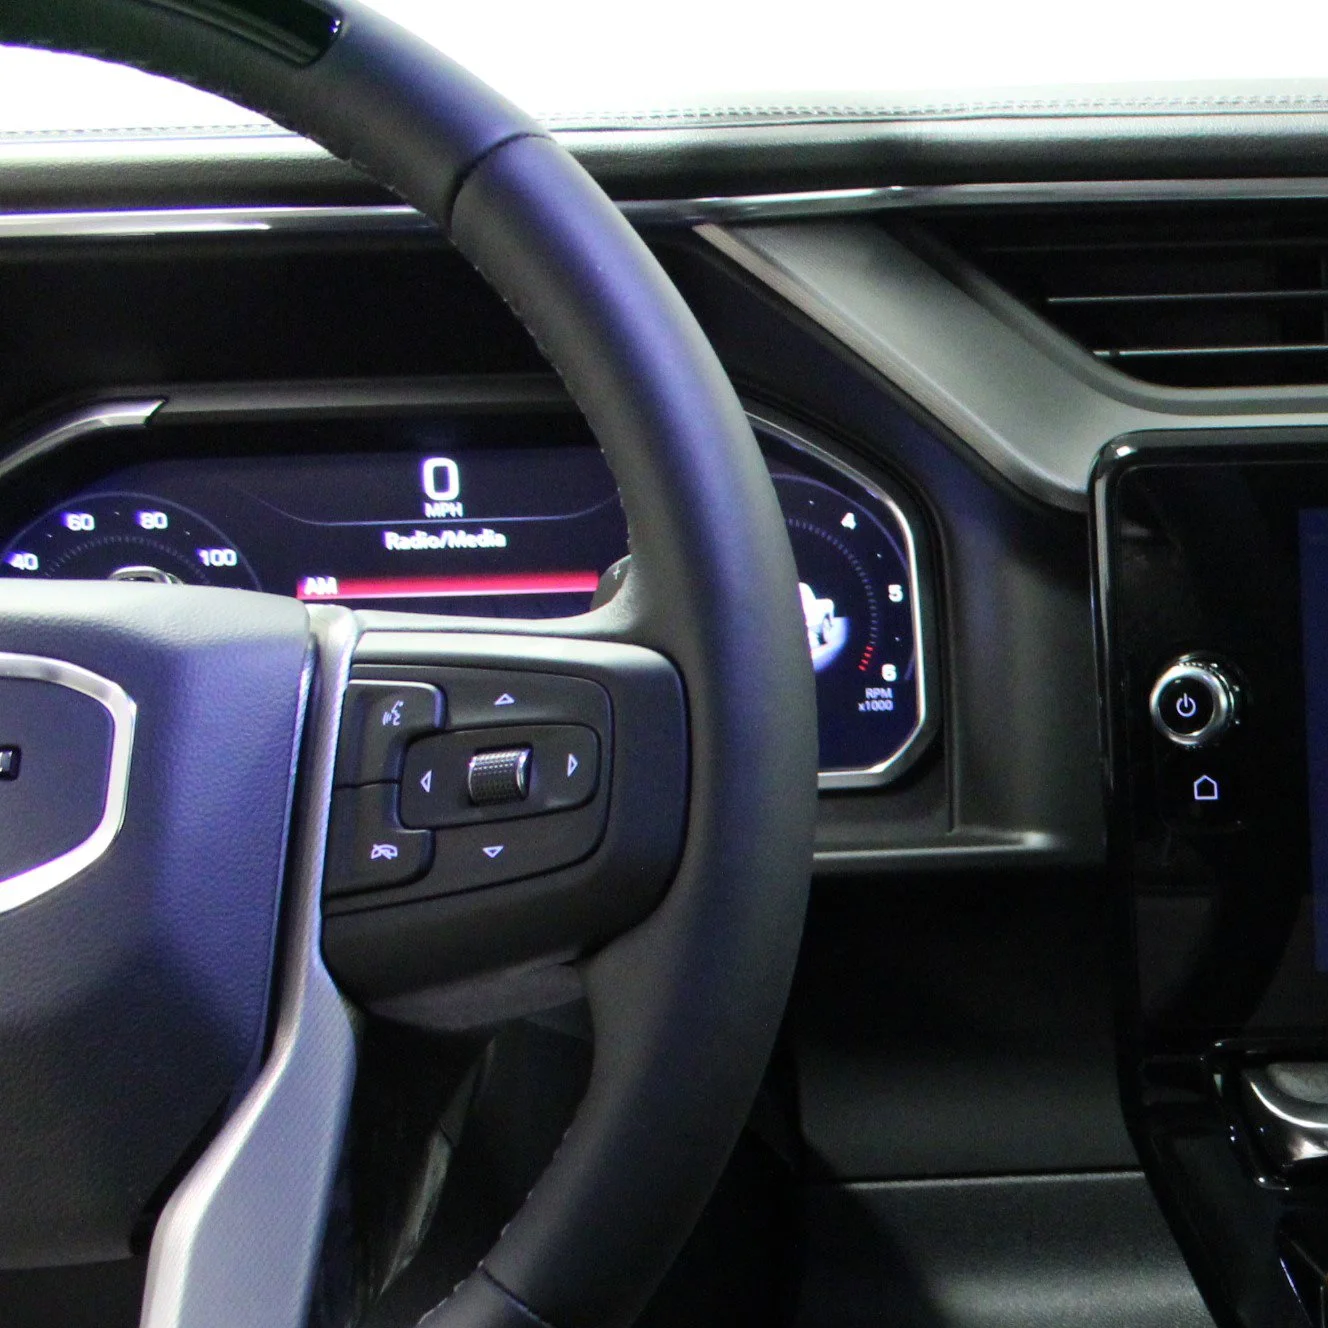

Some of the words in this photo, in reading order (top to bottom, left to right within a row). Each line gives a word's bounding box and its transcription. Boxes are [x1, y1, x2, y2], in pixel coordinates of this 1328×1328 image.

[422, 457, 459, 501] 0
[424, 502, 463, 517] MPH
[65, 512, 95, 531] 60
[137, 511, 168, 529] 80
[840, 512, 856, 529] 4
[384, 529, 507, 550] Radio/Media
[9, 552, 39, 570] 40
[199, 549, 237, 566] 100
[304, 576, 338, 595] AM
[888, 584, 903, 602] 5
[882, 664, 896, 681] 6
[865, 688, 893, 699] RPM
[858, 700, 893, 711] x1000
